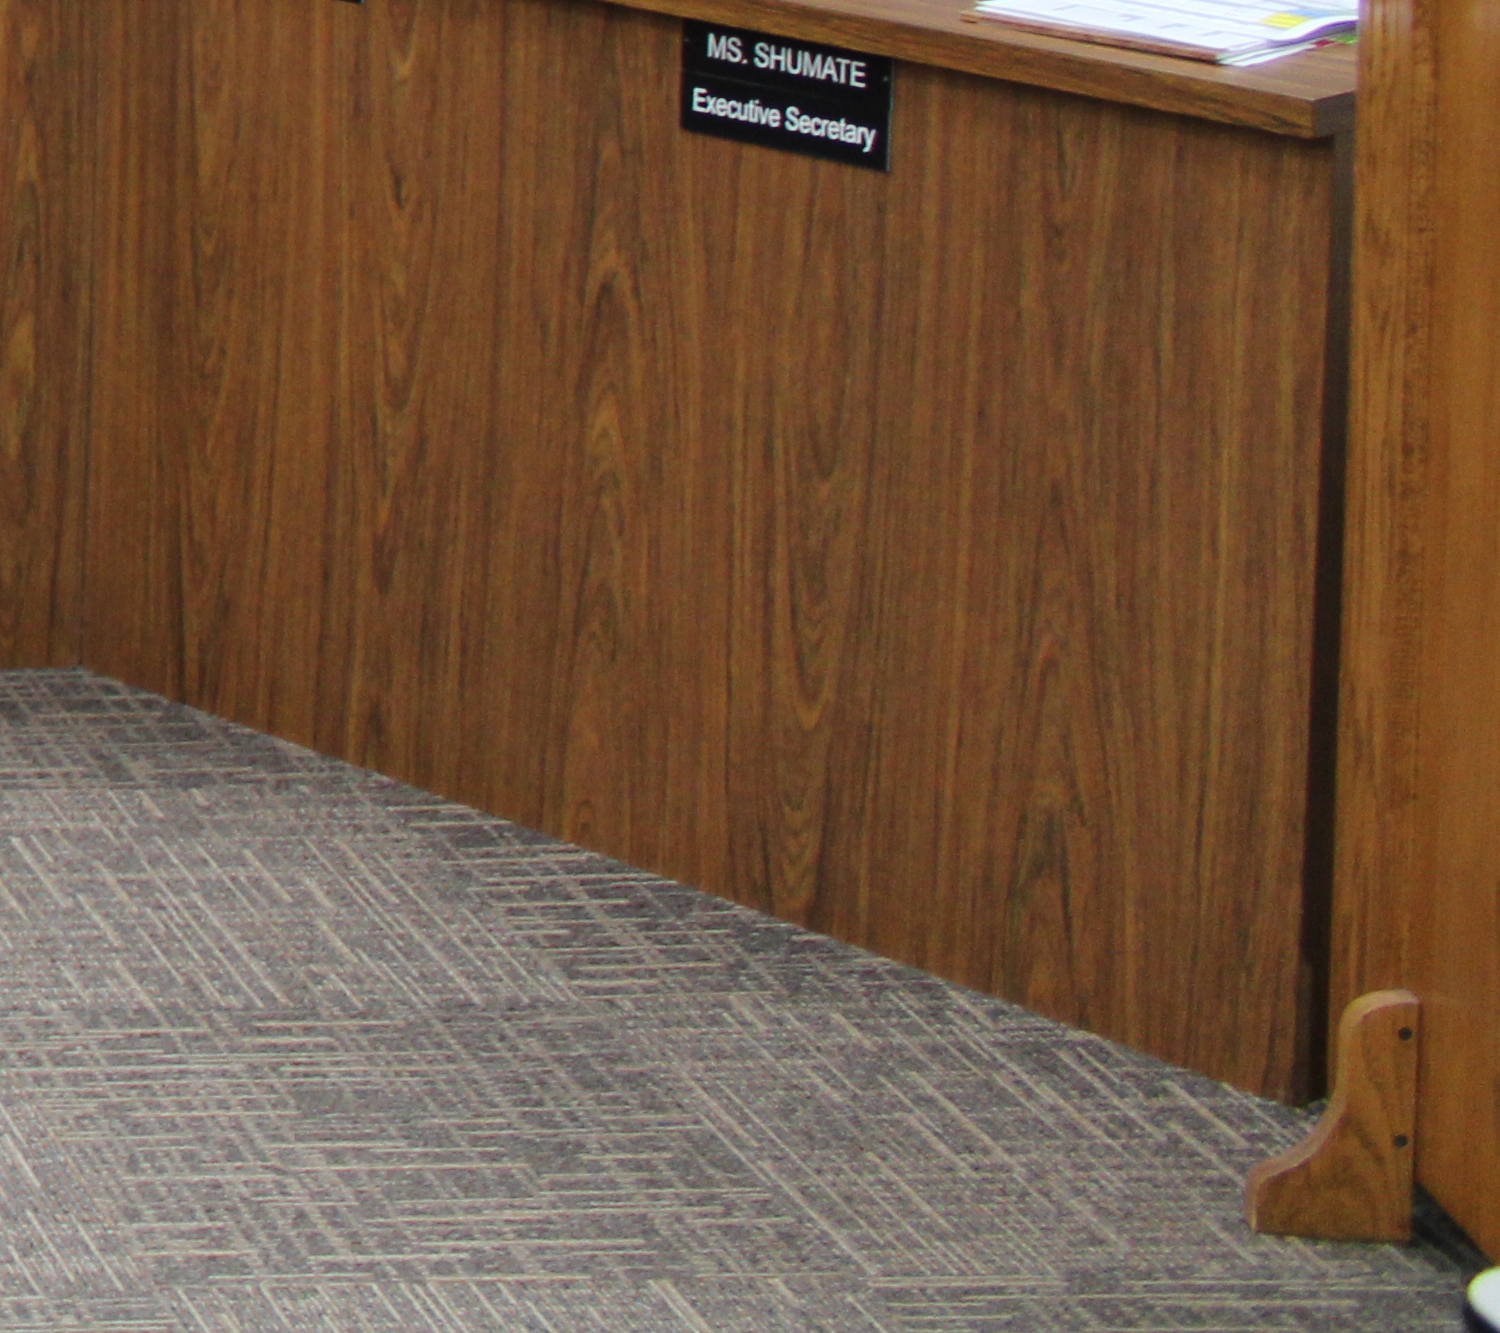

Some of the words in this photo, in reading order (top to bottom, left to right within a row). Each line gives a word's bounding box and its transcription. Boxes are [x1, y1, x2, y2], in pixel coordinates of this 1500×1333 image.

[707, 33, 748, 64] MS.
[753, 42, 867, 88] SHUMATE
[692, 87, 781, 128] Executive
[785, 106, 877, 153] Secretary
